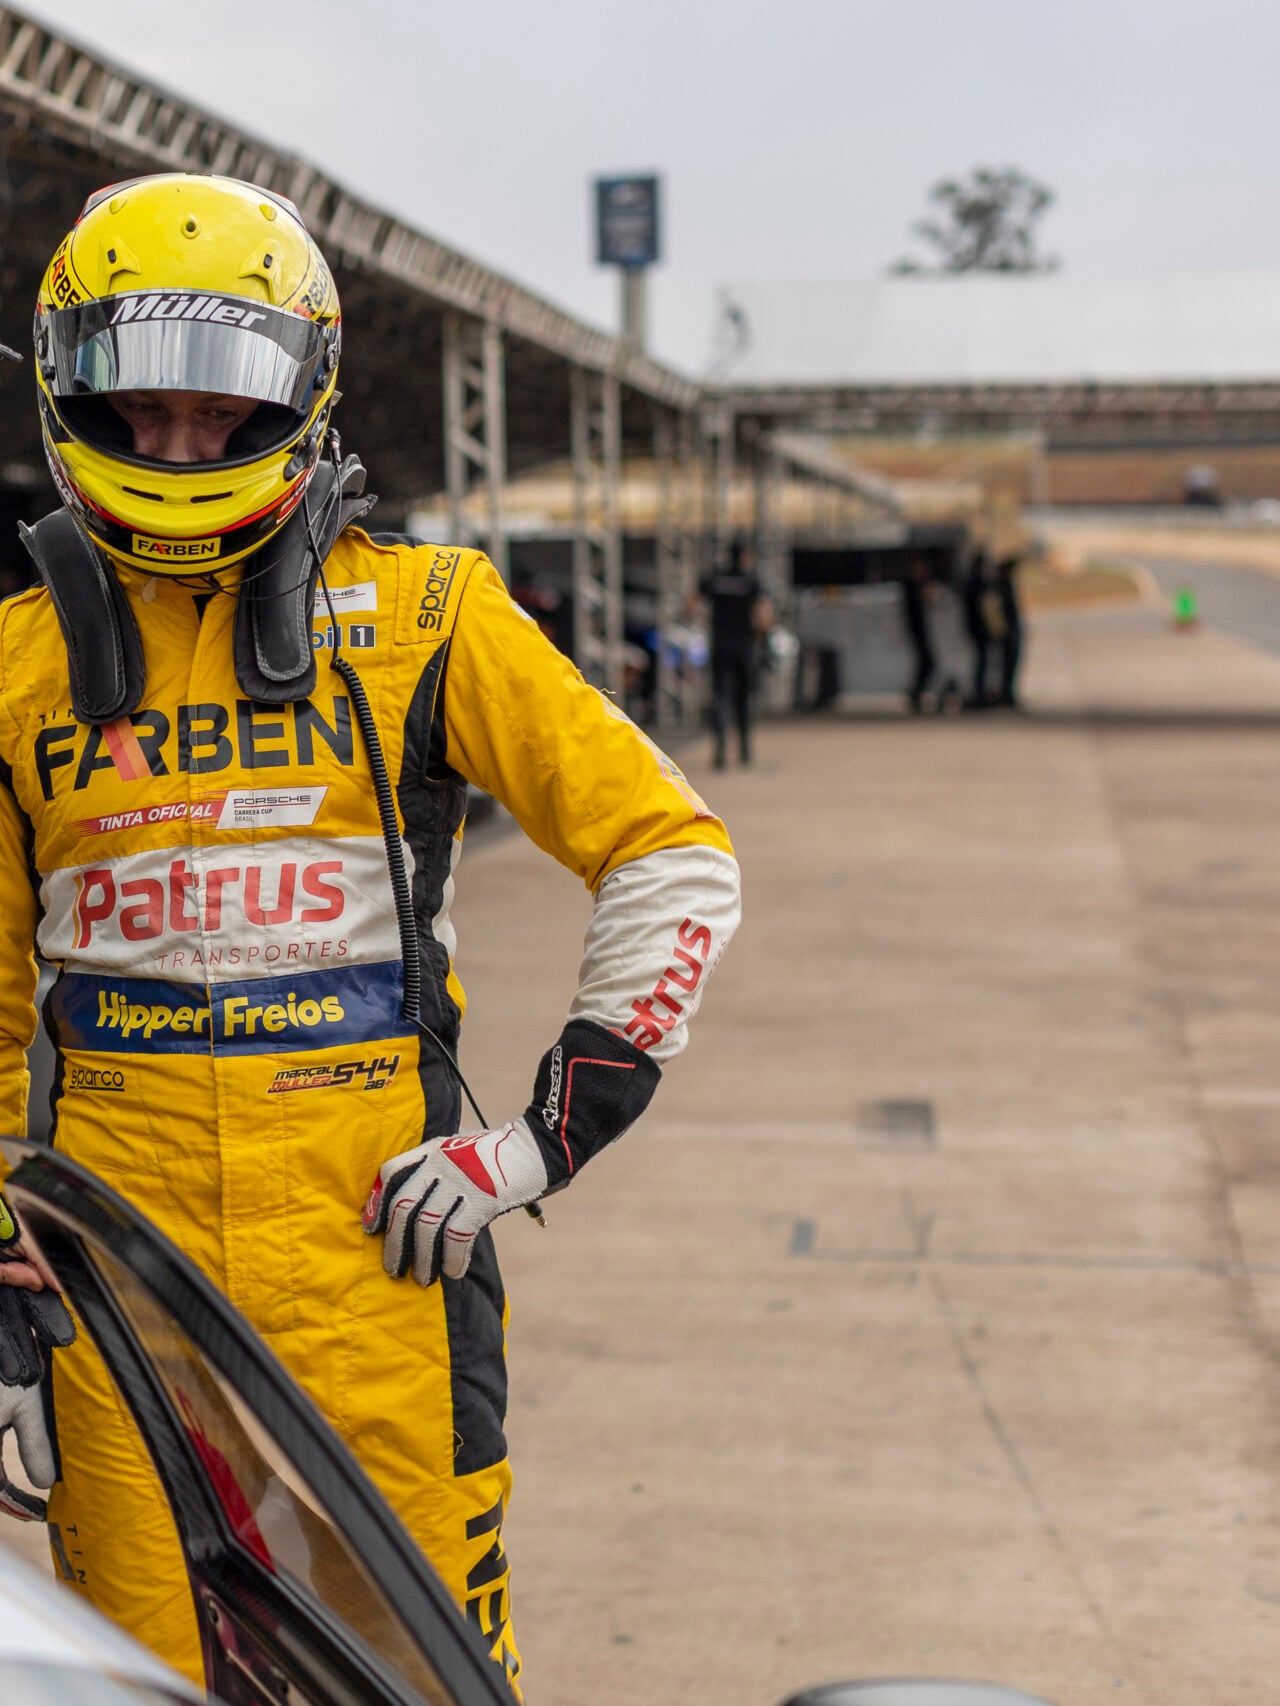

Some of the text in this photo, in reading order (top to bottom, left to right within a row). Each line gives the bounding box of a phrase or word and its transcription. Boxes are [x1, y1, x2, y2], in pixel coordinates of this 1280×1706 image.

[110, 293, 267, 329] Müller
[137, 540, 214, 556] FARBEN
[417, 550, 460, 631] sparco
[34, 696, 354, 802] FARBEN
[99, 802, 214, 832] TINTA OFICIAL
[233, 795, 311, 806] PORSCHE
[72, 859, 346, 949] Patrus
[158, 939, 349, 970] TRANSPORTES
[96, 990, 345, 1039] Hipper Freios
[70, 1069, 124, 1091] sparco
